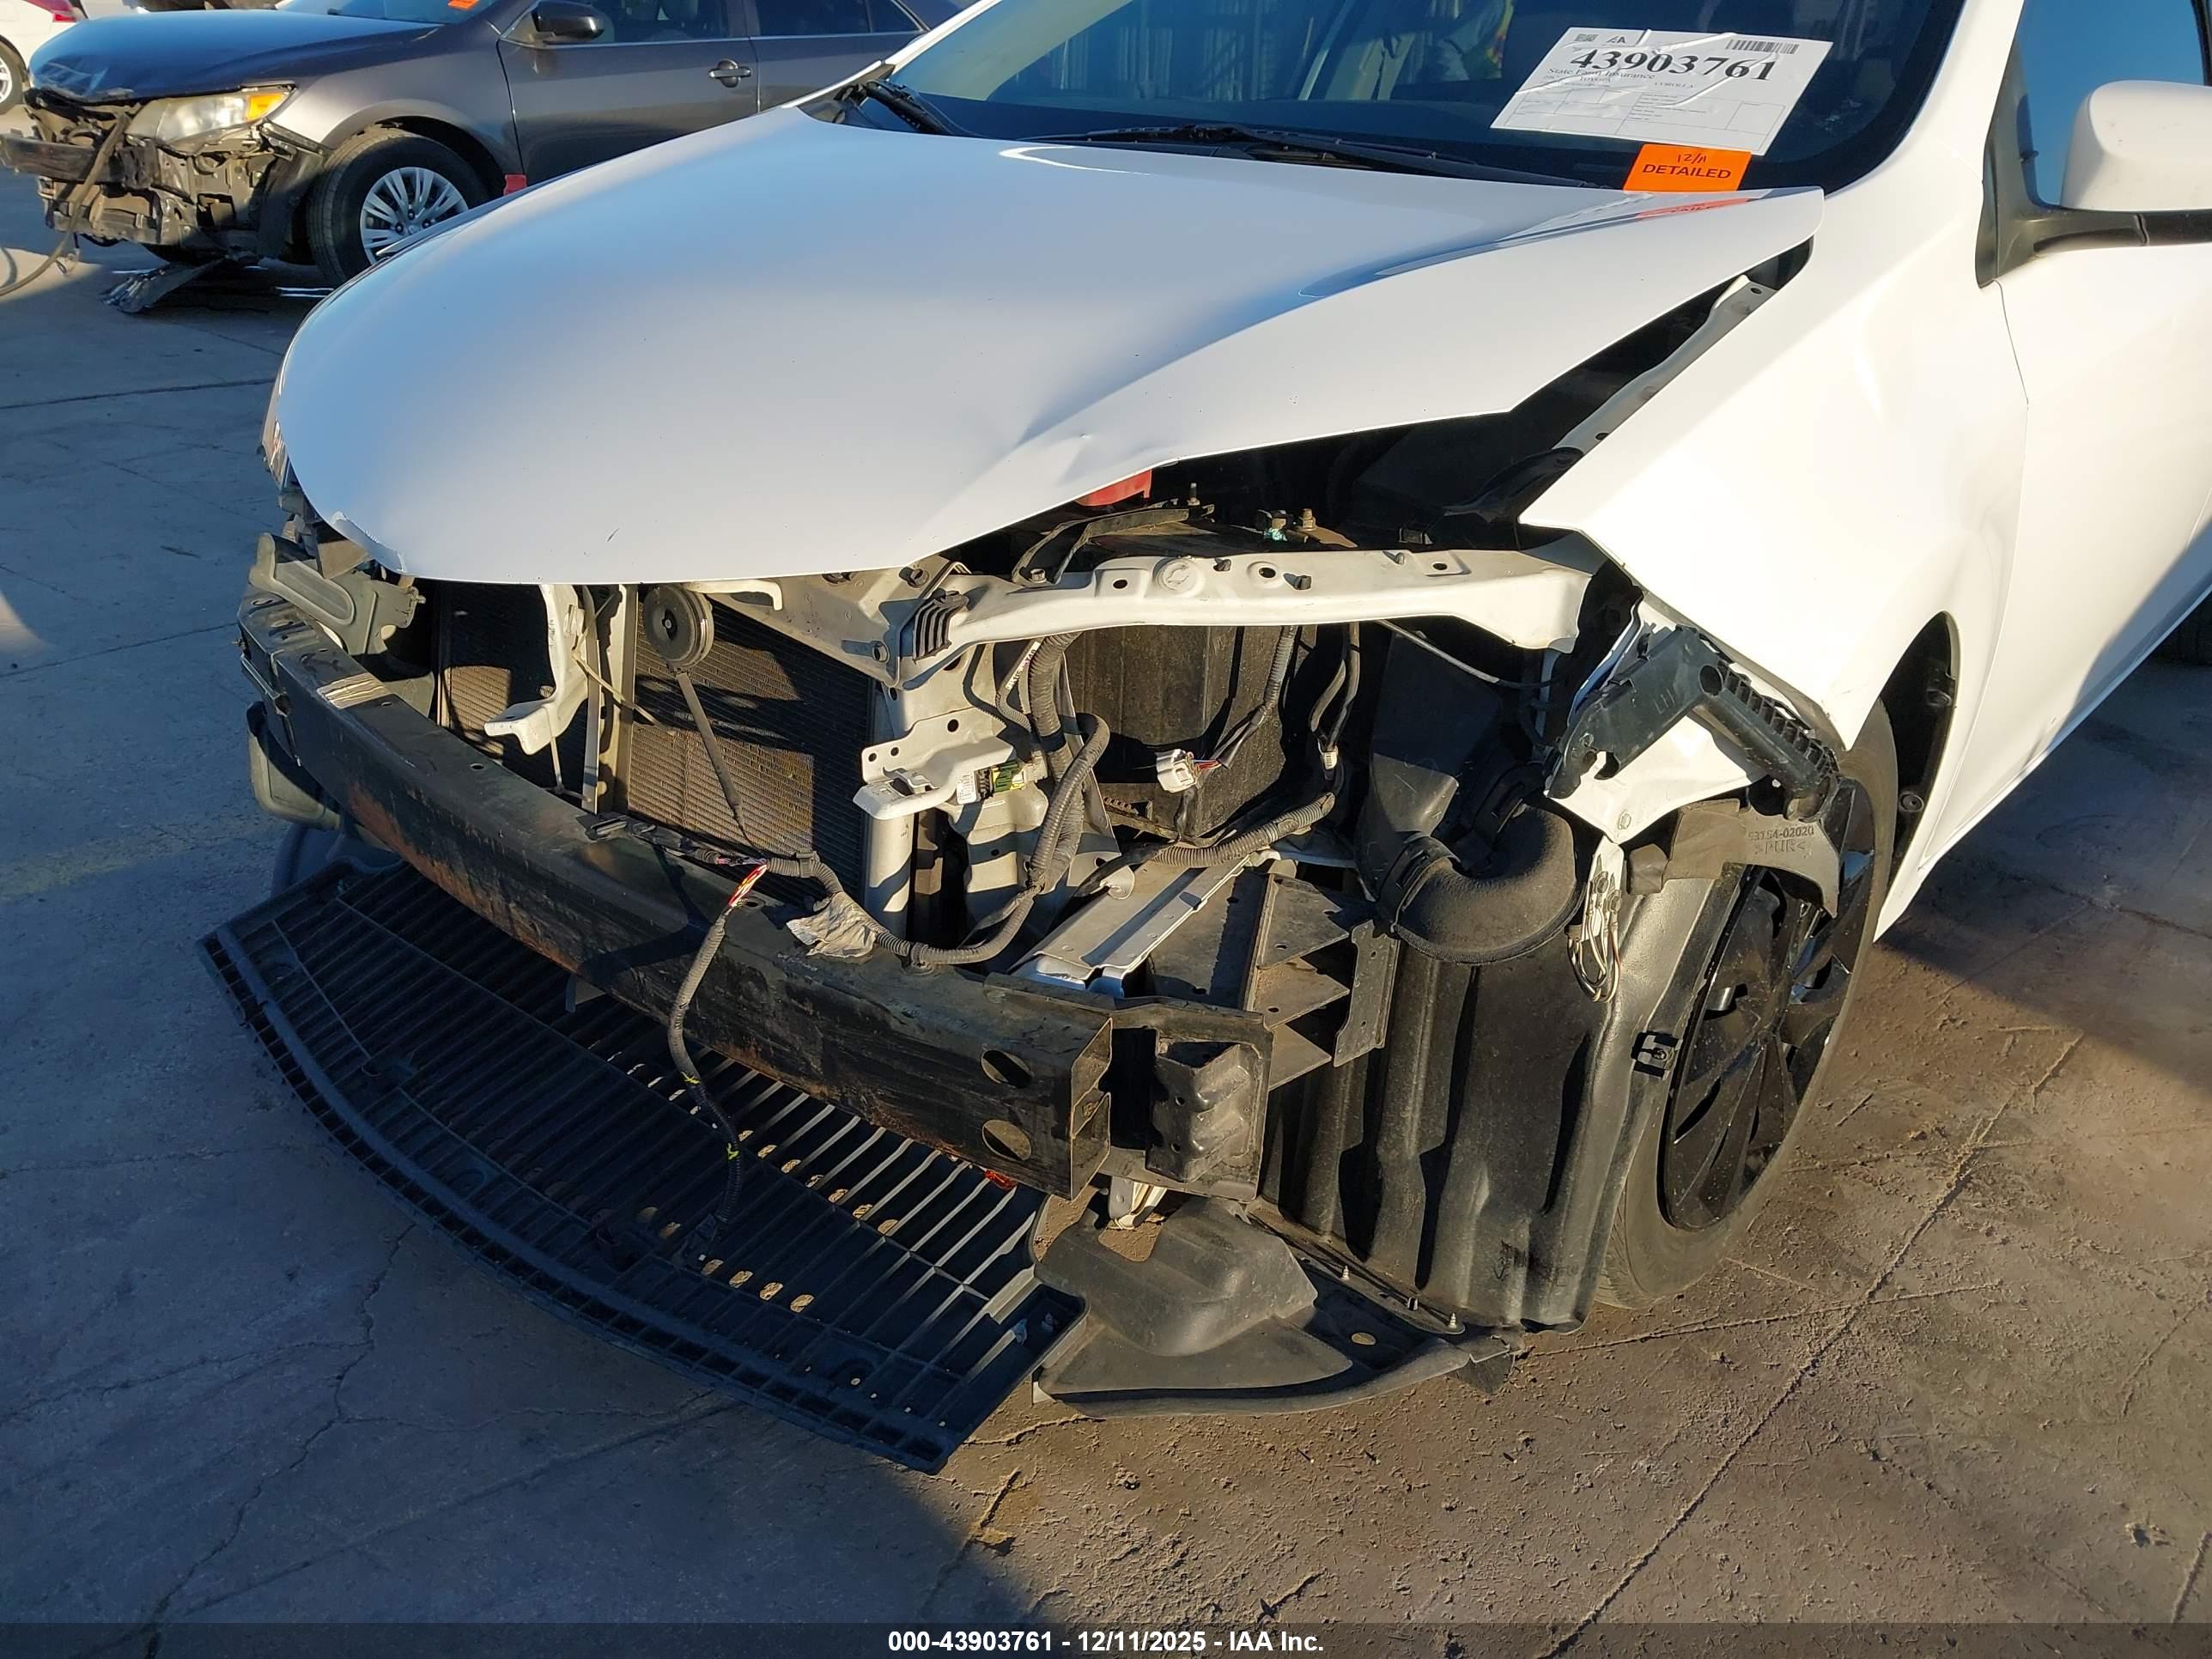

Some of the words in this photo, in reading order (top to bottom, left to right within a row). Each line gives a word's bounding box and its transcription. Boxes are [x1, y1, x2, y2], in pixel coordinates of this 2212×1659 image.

[1570, 49, 1778, 82] 43903761
[1604, 70, 1656, 80] Insurance
[1642, 164, 1732, 179] DETAILED
